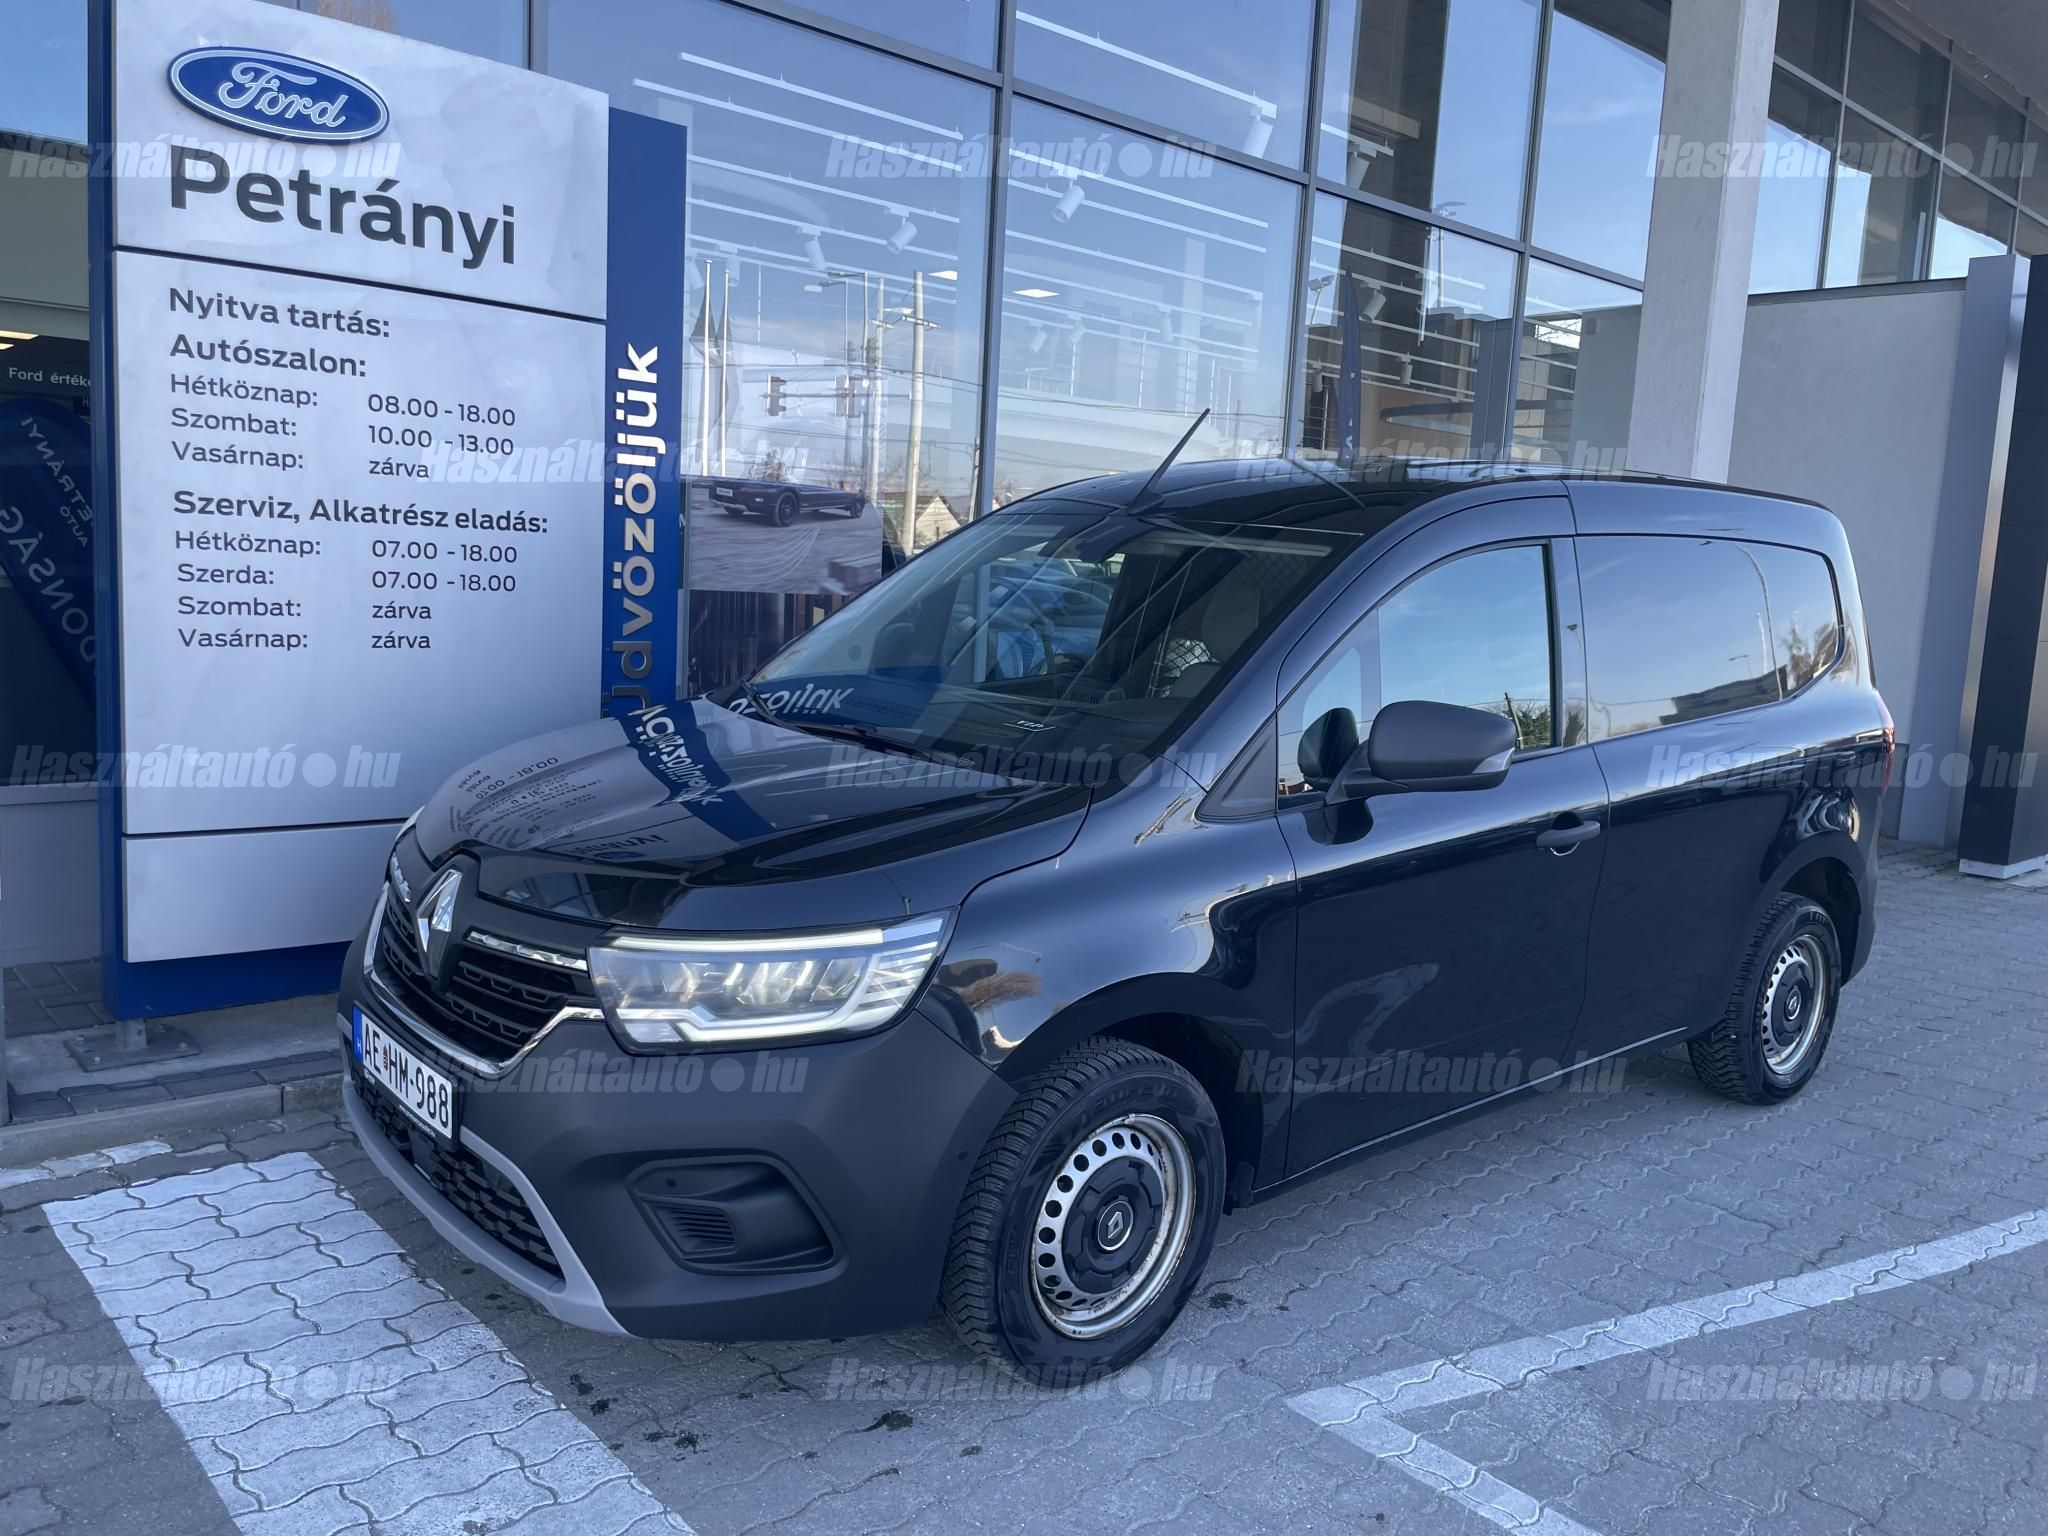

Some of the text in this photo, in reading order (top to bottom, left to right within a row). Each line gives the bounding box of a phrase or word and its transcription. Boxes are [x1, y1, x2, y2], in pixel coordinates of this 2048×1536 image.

[218, 62, 349, 127] Ford
[170, 144, 515, 270] Petrányi
[169, 287, 390, 338] Nyitva tartás:
[8, 366, 43, 382] Ford
[169, 333, 366, 377] Autószalon:
[170, 373, 318, 408] Hétköznap:
[367, 393, 439, 418] 08.00
[457, 403, 516, 426] 18.00
[171, 407, 297, 436] Szombat:
[368, 425, 432, 448] 10.00
[458, 434, 514, 456] 13.00
[171, 441, 430, 479] Vasárnap: zárva
[173, 490, 548, 534] Szerviz, Alkatrész eladás:
[175, 530, 321, 558] Hétköznap:
[372, 540, 438, 560] 07.00
[460, 544, 518, 563] 18.00
[177, 563, 274, 585] Szerda:
[372, 571, 438, 590] 07.00
[459, 574, 516, 592] 18.00
[178, 596, 432, 619] Szombat: zárva
[178, 628, 431, 651] Vasárnap: zárva
[364, 1022, 382, 1076] AE
[388, 1042, 449, 1129] HM-988
